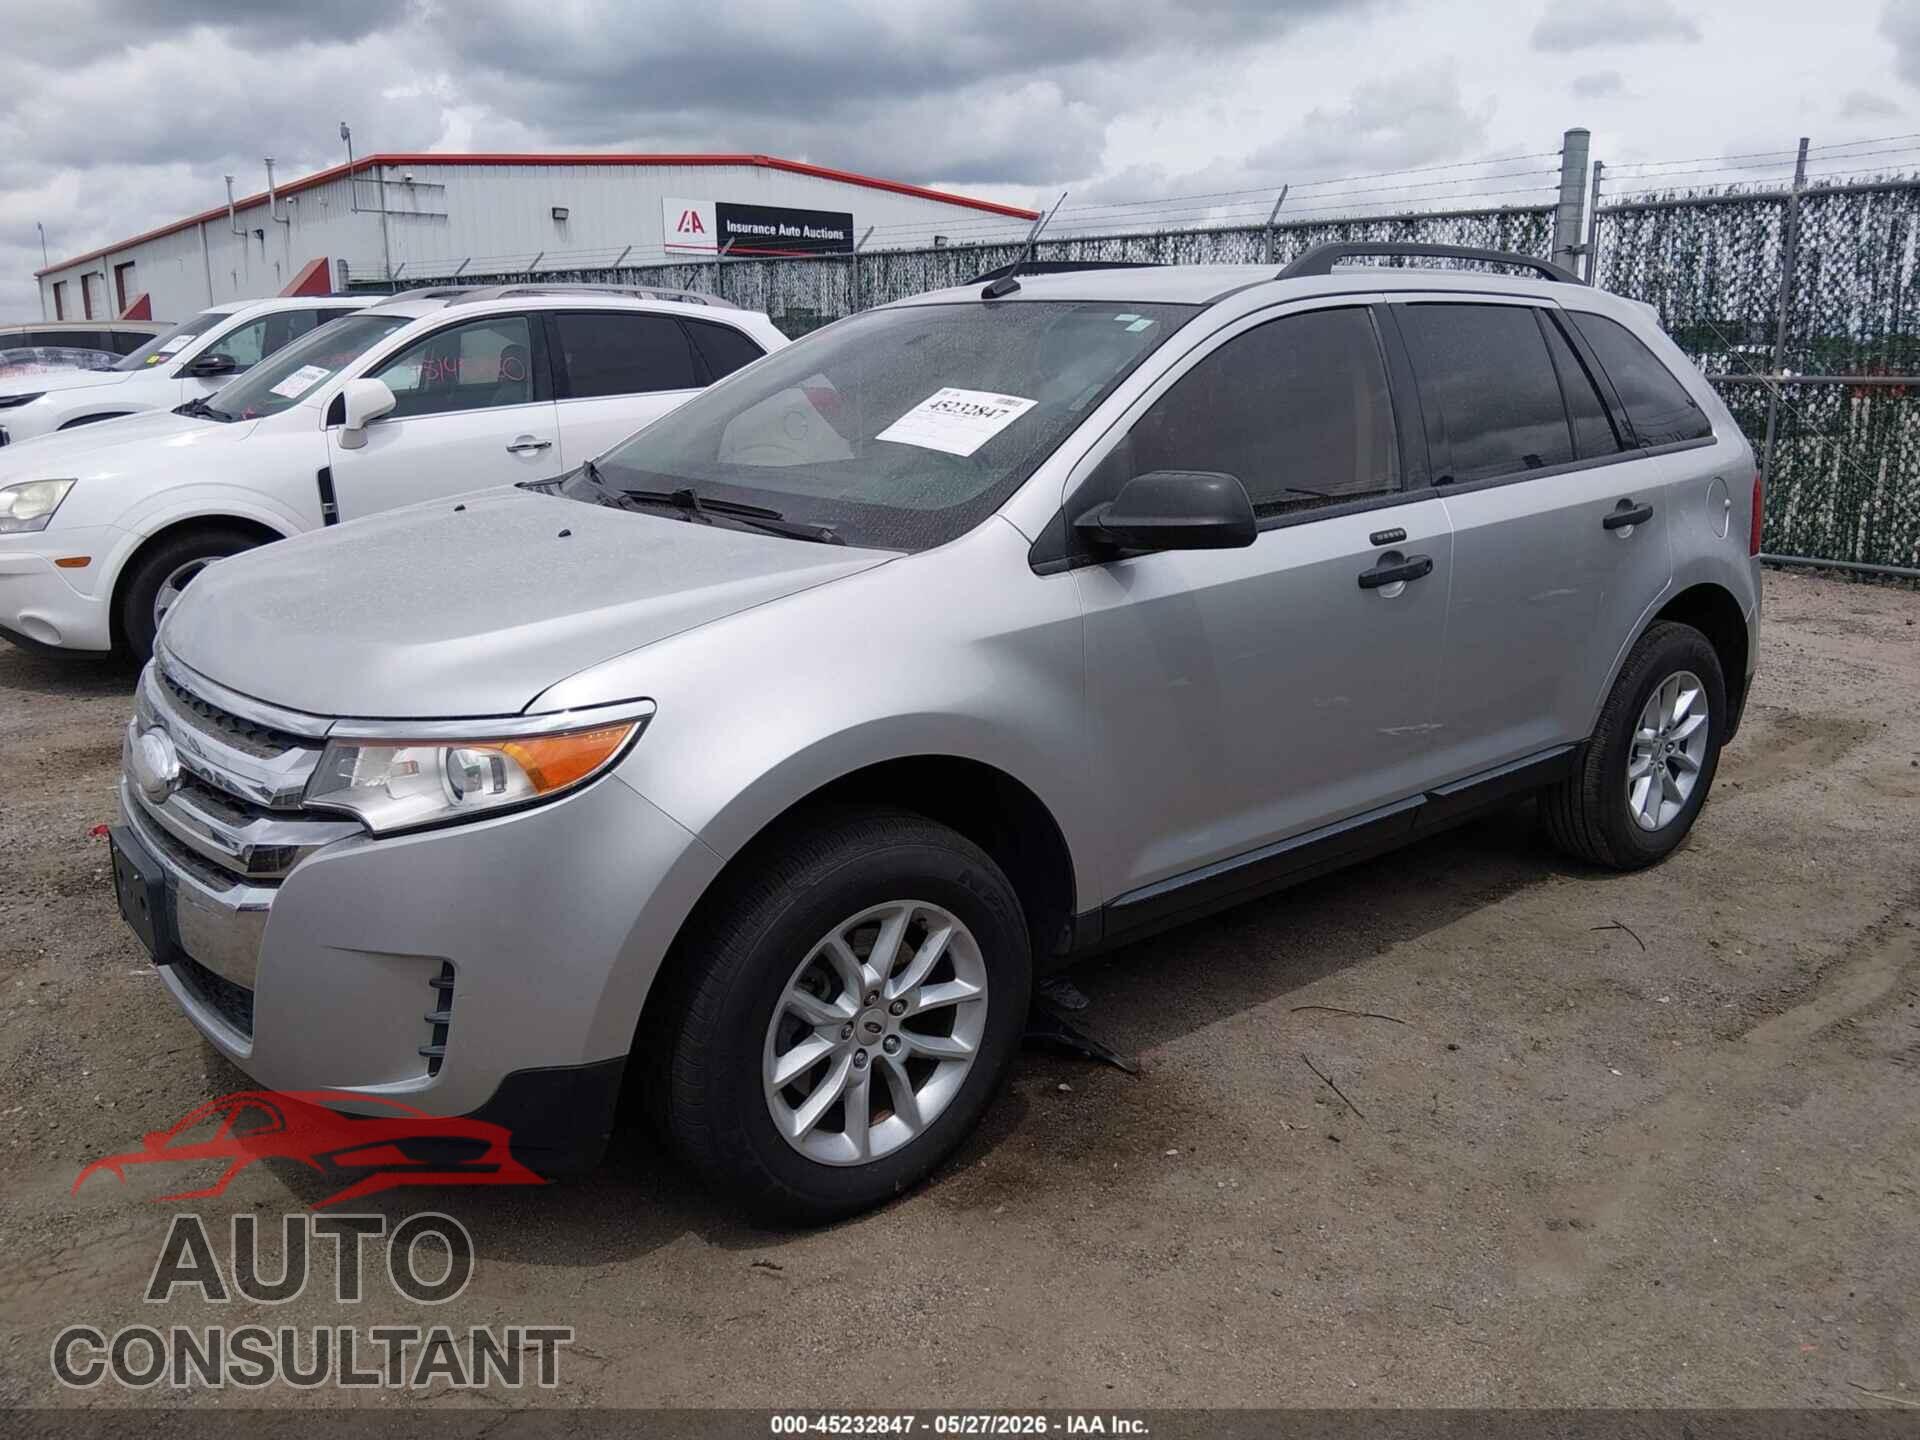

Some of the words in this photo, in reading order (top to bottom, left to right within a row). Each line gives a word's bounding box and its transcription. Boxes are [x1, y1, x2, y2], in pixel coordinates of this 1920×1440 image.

[726, 219, 776, 235] Insurance
[778, 223, 801, 237] Auto
[802, 224, 844, 240] Auctions
[929, 399, 1010, 420] 45232847
